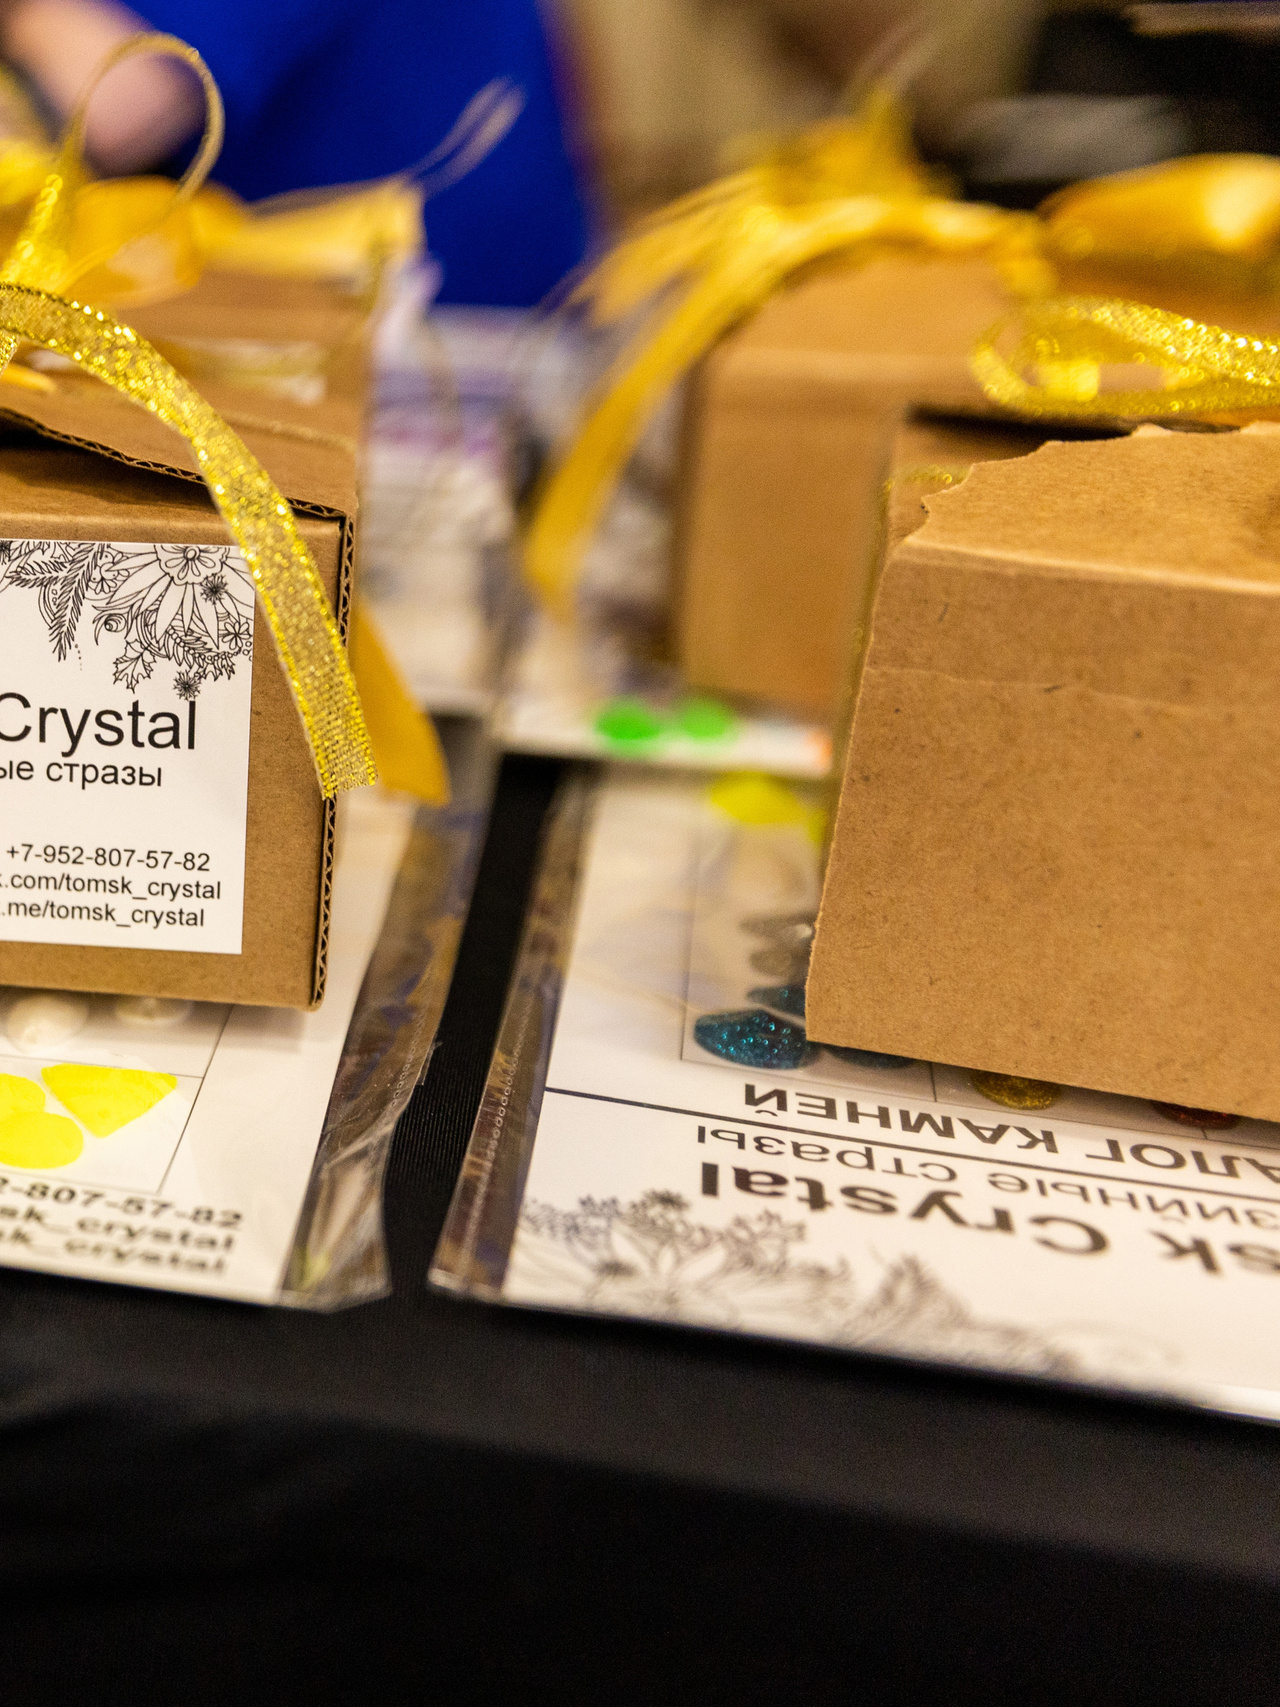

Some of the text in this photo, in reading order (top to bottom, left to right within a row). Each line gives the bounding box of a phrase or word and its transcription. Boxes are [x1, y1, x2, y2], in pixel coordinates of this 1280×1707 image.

[46, 761, 162, 790] стразы
[7, 844, 210, 871] +7-952-807-57-82
[744, 1083, 1058, 1154] КАМНЕЙ
[697, 1125, 957, 1182] стразы
[701, 1162, 1109, 1256] Crystal
